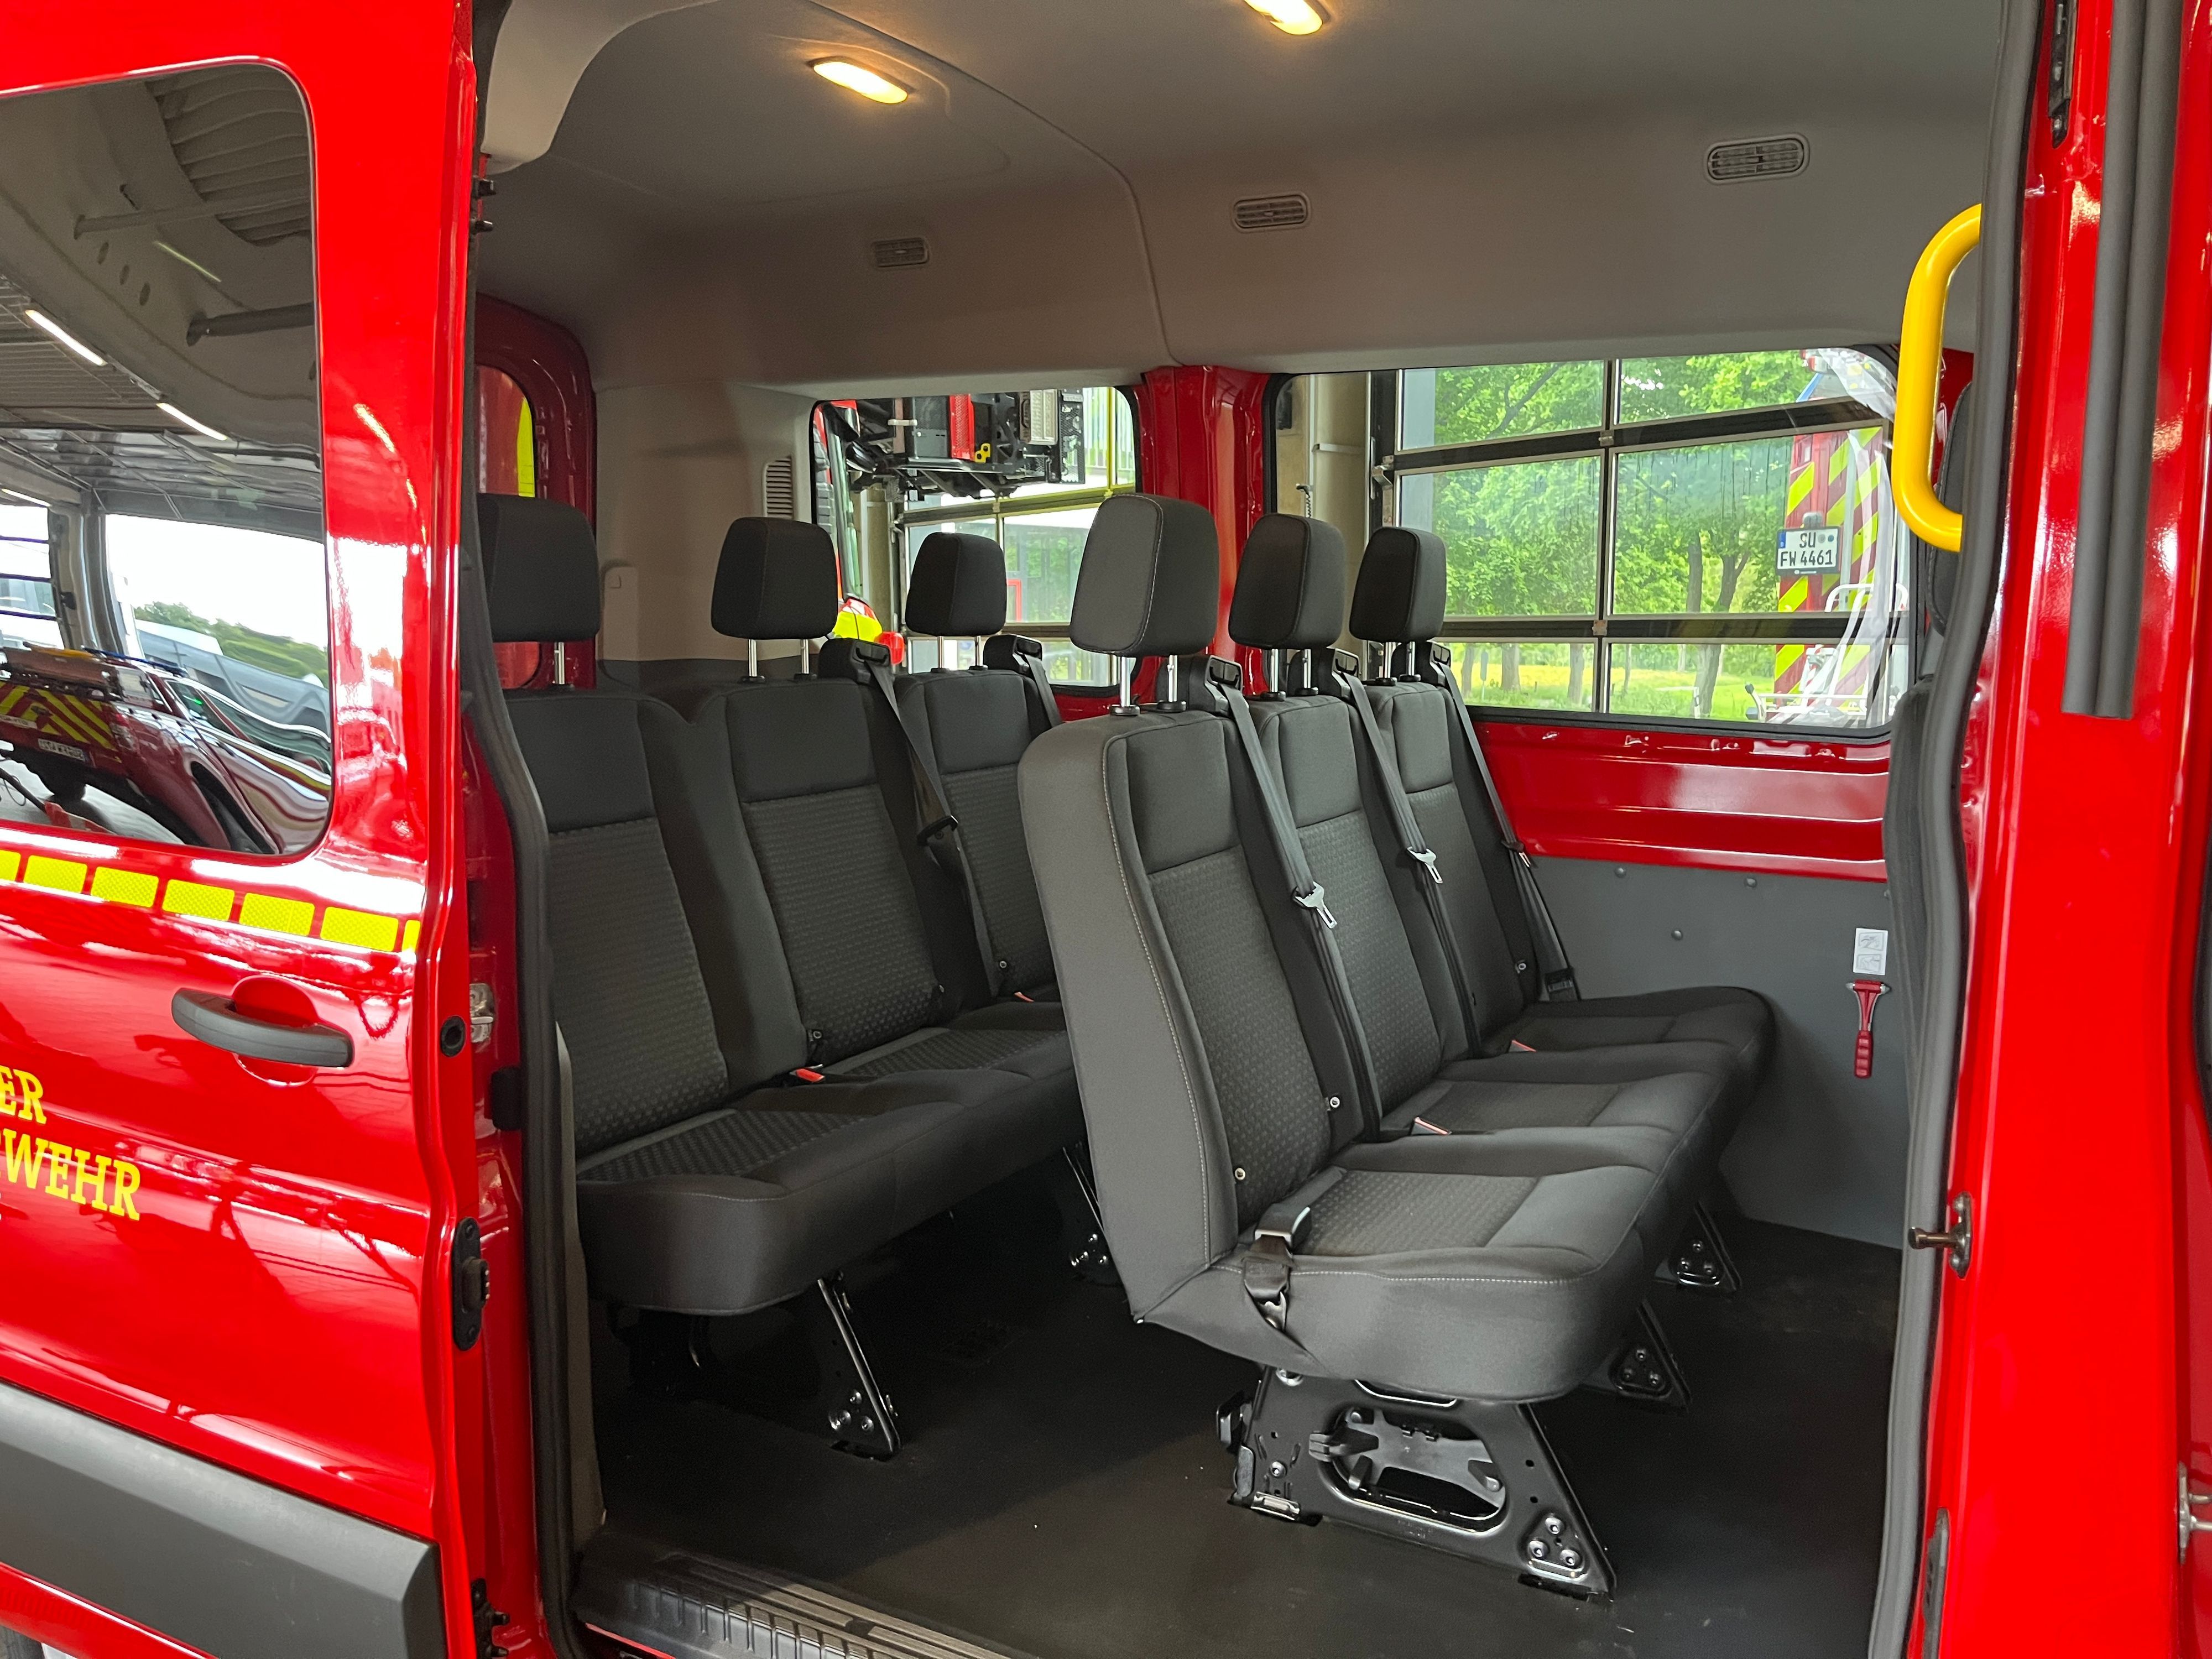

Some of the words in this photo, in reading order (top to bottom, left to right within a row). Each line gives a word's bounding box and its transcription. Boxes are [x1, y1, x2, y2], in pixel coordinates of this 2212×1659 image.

[1799, 532, 1816, 548] SU
[1780, 551, 1796, 567] FW
[1800, 549, 1833, 566] 4461
[0, 1128, 140, 1220] WEHR
